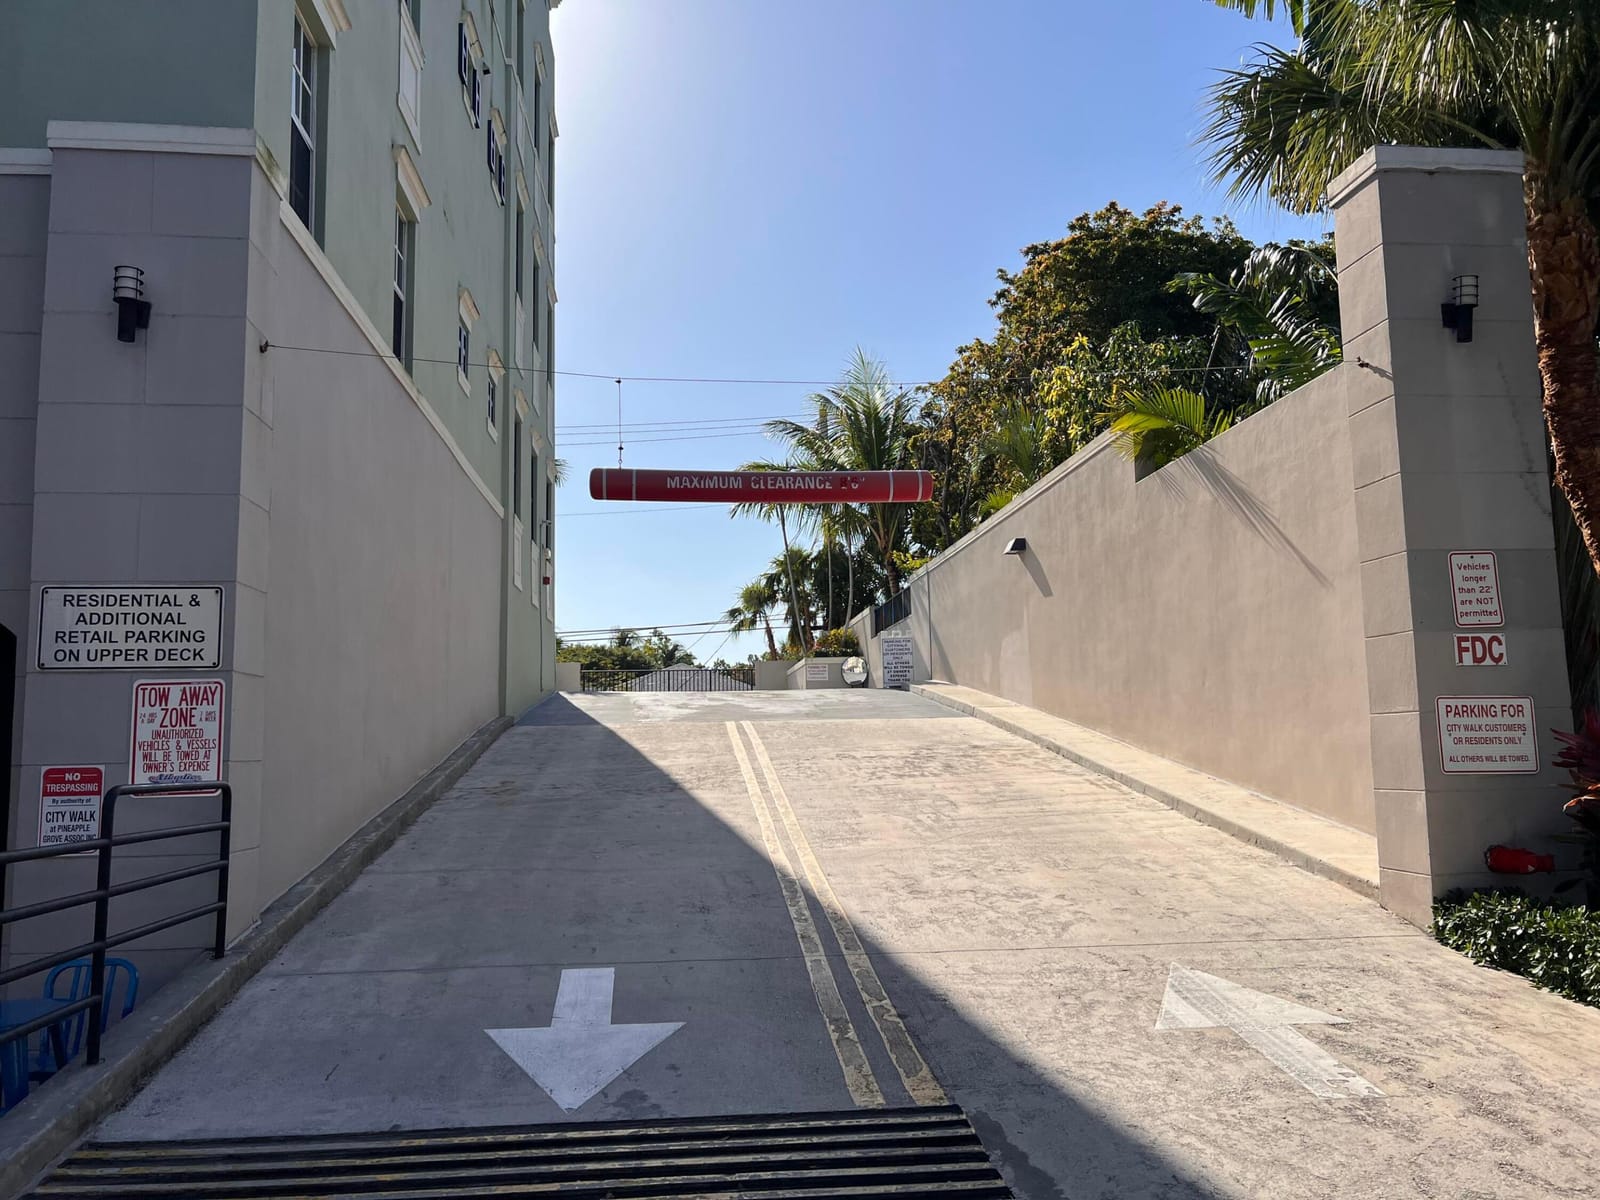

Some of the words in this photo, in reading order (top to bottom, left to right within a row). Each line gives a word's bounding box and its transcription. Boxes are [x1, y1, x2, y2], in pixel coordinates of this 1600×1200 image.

[667, 476, 742, 489] MAXIMUM
[751, 476, 832, 489] CLEARANCE
[1457, 563, 1490, 571] Vehicles
[1462, 575, 1487, 583] longer
[1458, 586, 1476, 594] than
[63, 594, 183, 607] RESIDENTIAL
[188, 594, 201, 607] &
[1476, 597, 1494, 605] NOT
[75, 612, 187, 626] ADDITIONAL
[1460, 609, 1498, 618] permitted
[55, 630, 118, 644] RETAIL
[124, 630, 206, 643] PARKING
[54, 649, 80, 662] ON
[87, 648, 148, 662] UPPER
[155, 648, 205, 661] DECK
[1456, 635, 1504, 664] FDC
[140, 687, 170, 707] TOW
[179, 686, 218, 706] AWAY
[1445, 704, 1497, 718] PARKING
[1501, 704, 1525, 718] FOR
[160, 708, 197, 728] ZONE
[152, 728, 204, 740] UNAUTHORIZED
[1446, 724, 1461, 732] CITY
[1463, 724, 1482, 732] WALK
[1485, 724, 1527, 732] CUSTOMERS
[138, 741, 170, 751] VEHICLES
[175, 740, 182, 750] &
[187, 739, 217, 750] VESSELS
[1453, 737, 1463, 745] OR
[1465, 736, 1502, 744] RESIDENTS
[1504, 736, 1522, 744] ONLY
[142, 752, 158, 762] WILL
[163, 751, 172, 762] BE
[177, 751, 199, 761] TOWED
[204, 750, 211, 760] AT
[143, 762, 174, 773] OWNER'S
[178, 761, 210, 772] EXPENSE
[65, 773, 81, 781] NO
[46, 783, 98, 792] TRESPASSING
[46, 811, 67, 823] CITY
[70, 810, 96, 822] WALK
[58, 824, 90, 832] PINEAPPLE
[43, 835, 63, 843] GROVE
